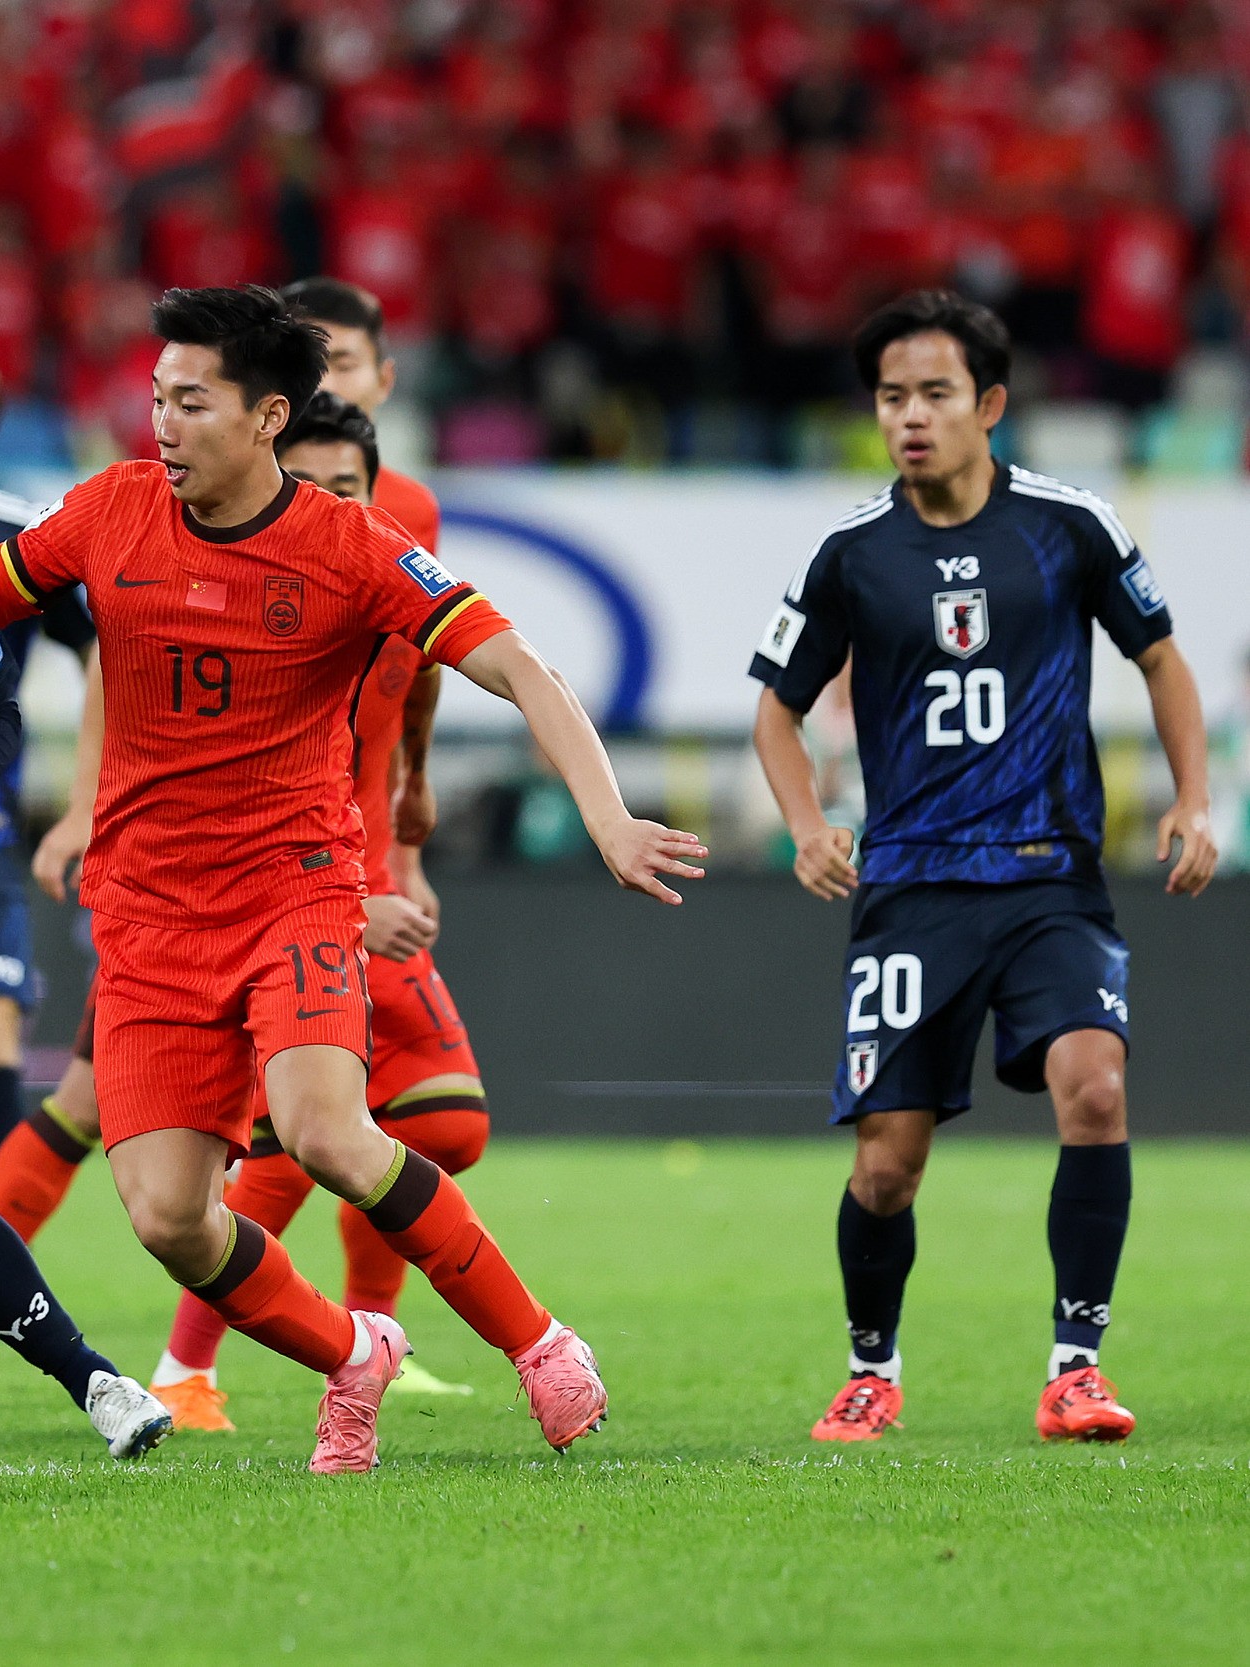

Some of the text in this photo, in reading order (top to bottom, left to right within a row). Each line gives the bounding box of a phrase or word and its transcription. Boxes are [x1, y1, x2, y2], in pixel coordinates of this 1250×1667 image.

[267, 579, 300, 592] CFA
[934, 555, 981, 583] Y-3
[165, 644, 234, 718] 19
[923, 667, 1007, 747] 20
[282, 940, 350, 997] 19
[847, 952, 923, 1034] 20
[1060, 1296, 1112, 1327] Y-3
